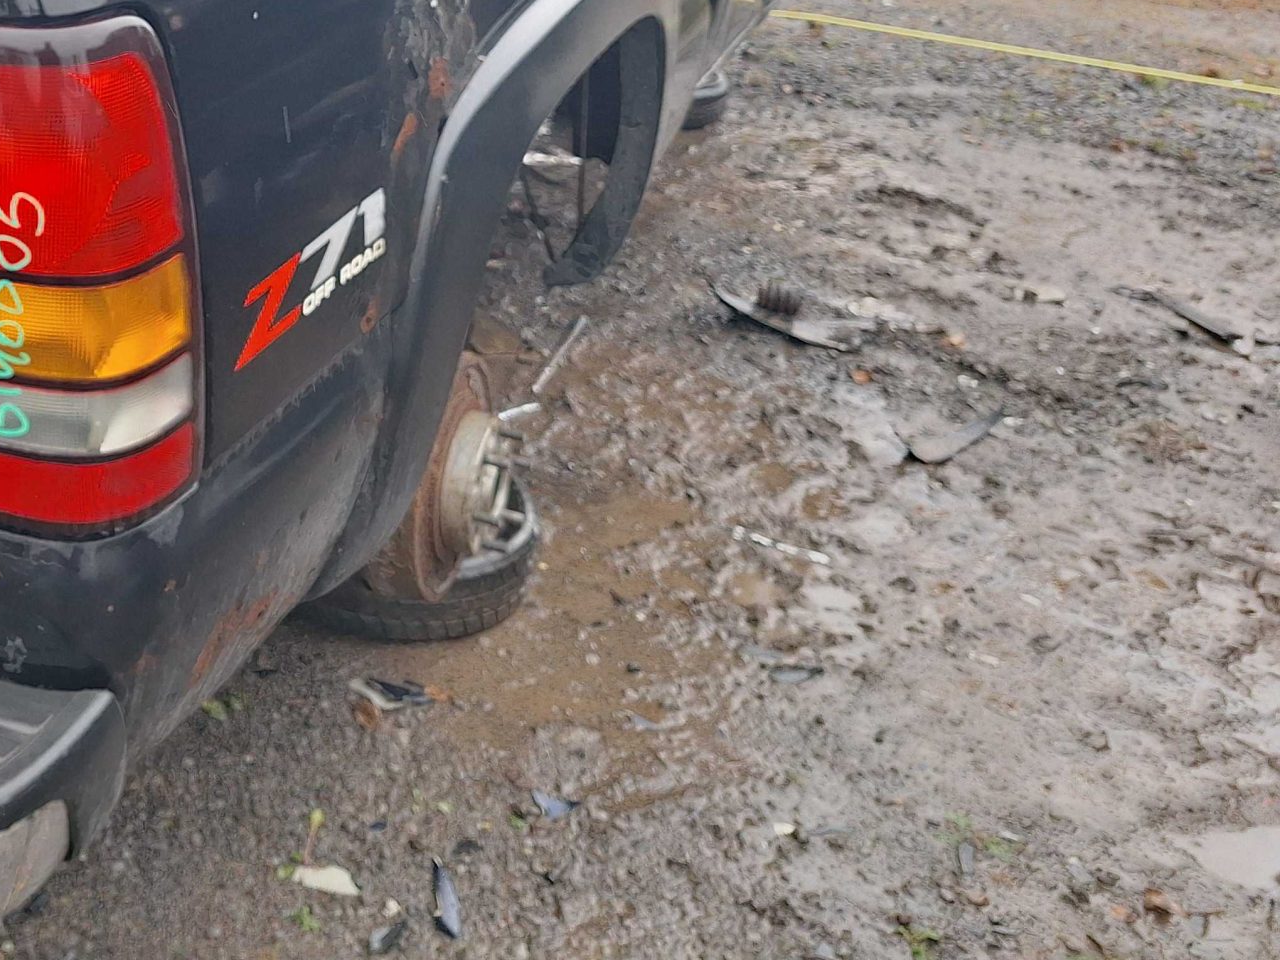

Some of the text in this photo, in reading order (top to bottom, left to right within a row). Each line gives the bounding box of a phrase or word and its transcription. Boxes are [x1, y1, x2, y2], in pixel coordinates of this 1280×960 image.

[233, 187, 385, 371] Z71
[302, 238, 386, 316] OFF ROAD
